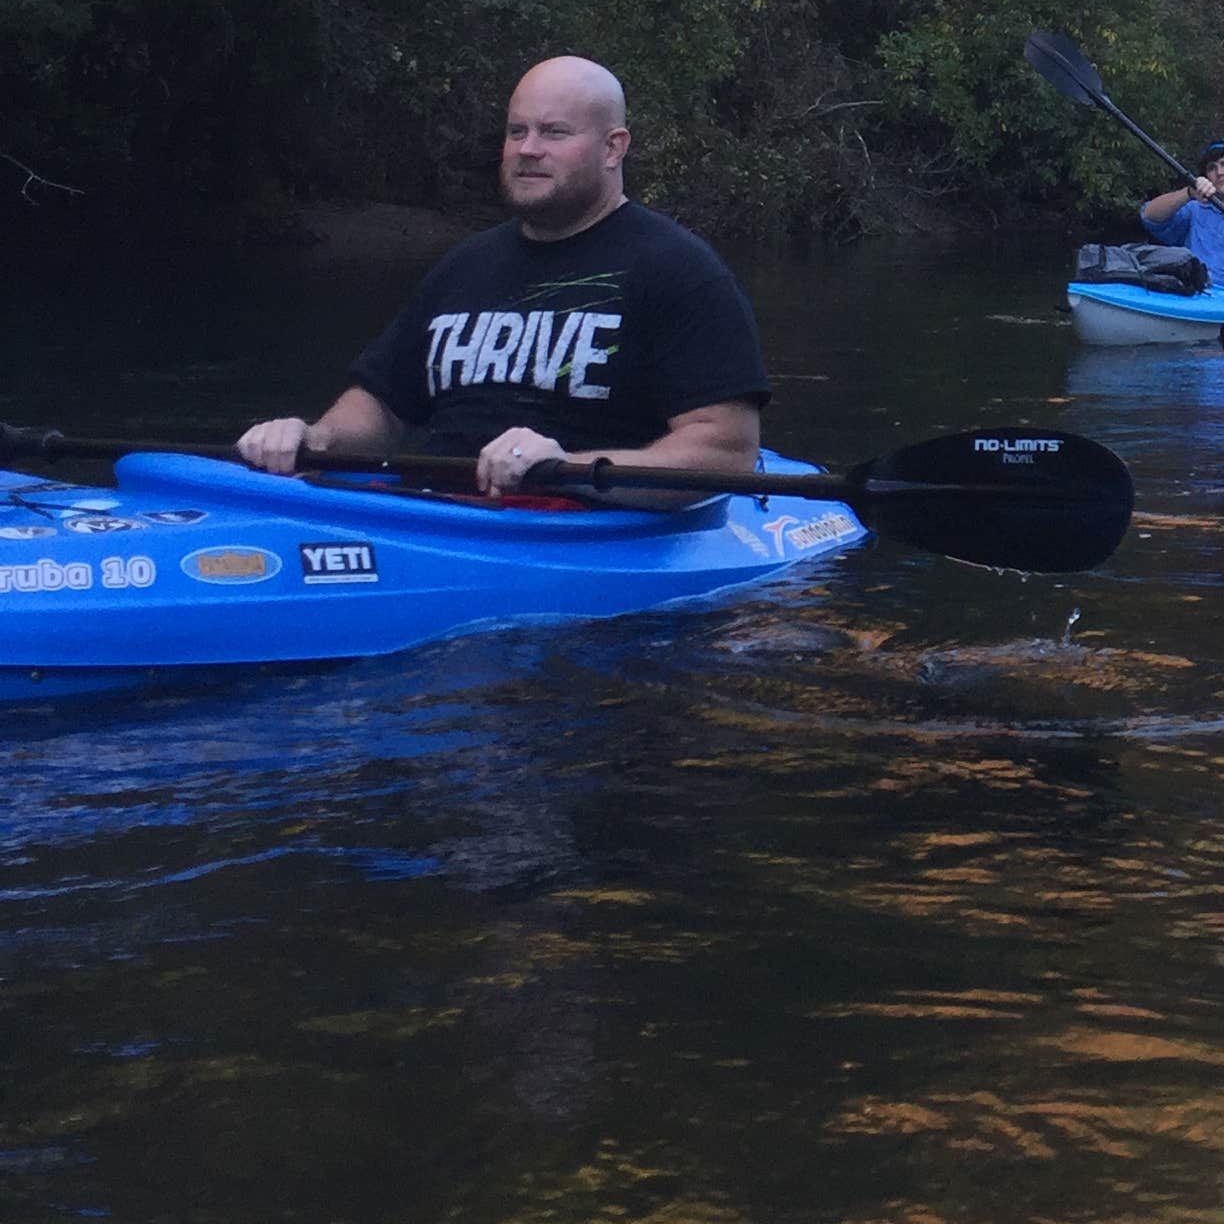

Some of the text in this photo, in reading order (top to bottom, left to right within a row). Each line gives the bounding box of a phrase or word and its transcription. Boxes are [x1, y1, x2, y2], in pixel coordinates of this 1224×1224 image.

[427, 310, 622, 399] THRIVE
[102, 556, 156, 588] 10
[303, 547, 371, 571] YETI
